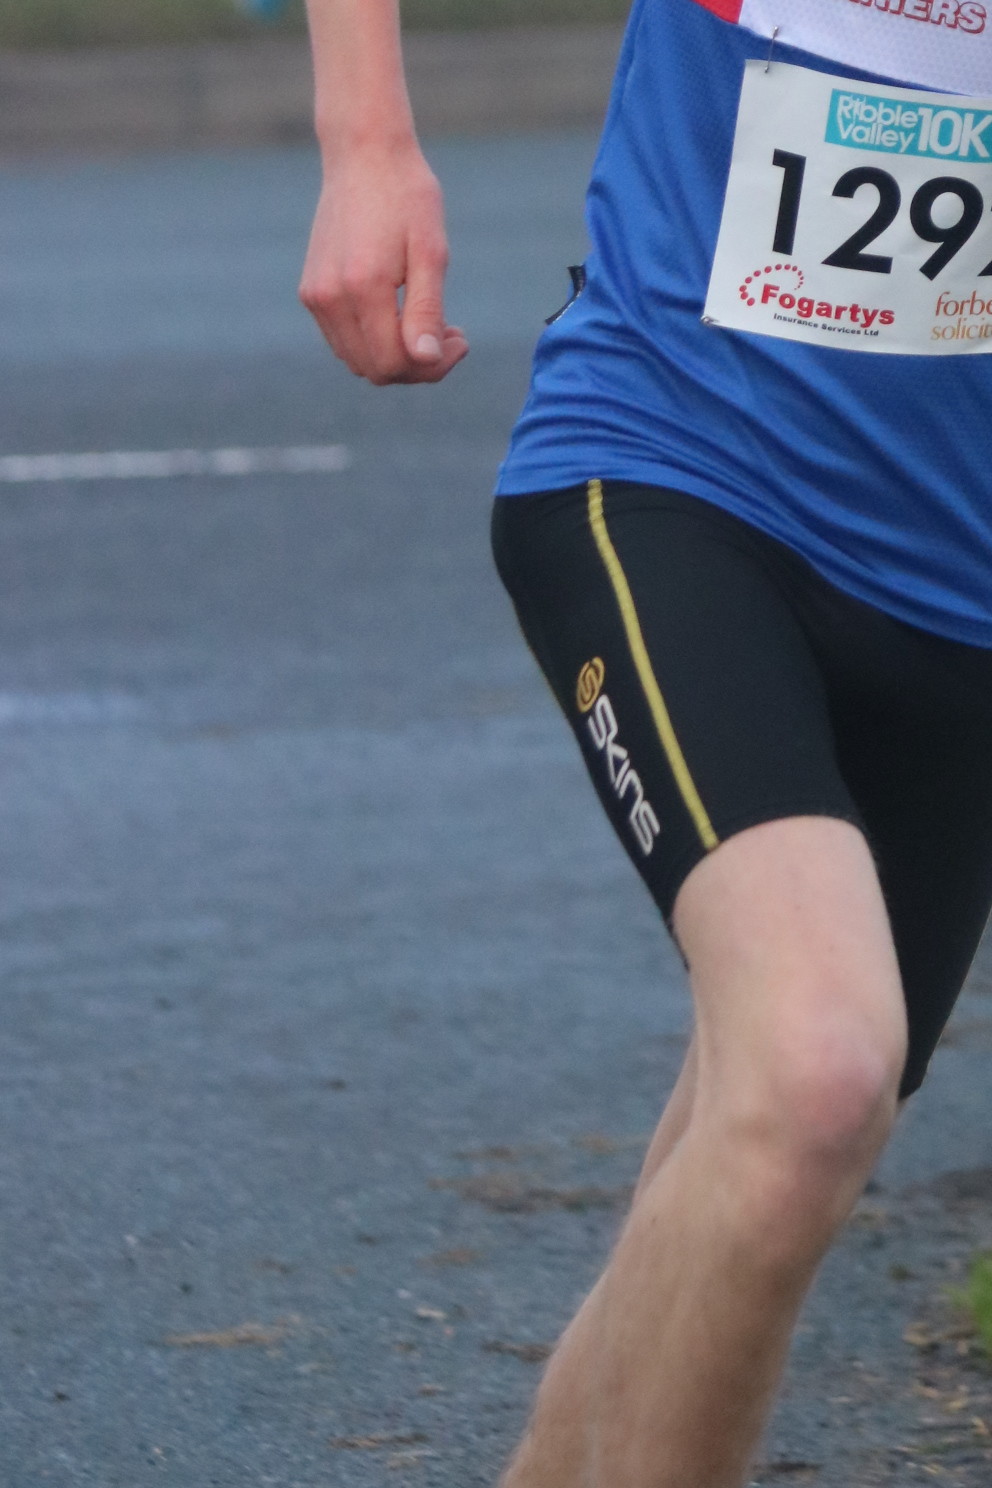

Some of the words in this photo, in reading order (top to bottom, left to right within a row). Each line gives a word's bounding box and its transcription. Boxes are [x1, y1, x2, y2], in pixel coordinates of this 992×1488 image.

[837, 94, 918, 128] Ribble
[837, 113, 916, 154] Valley
[761, 283, 896, 329] Fogartys
[773, 313, 819, 329] Insurance
[821, 323, 861, 336] Services
[864, 329, 880, 337] Ltd
